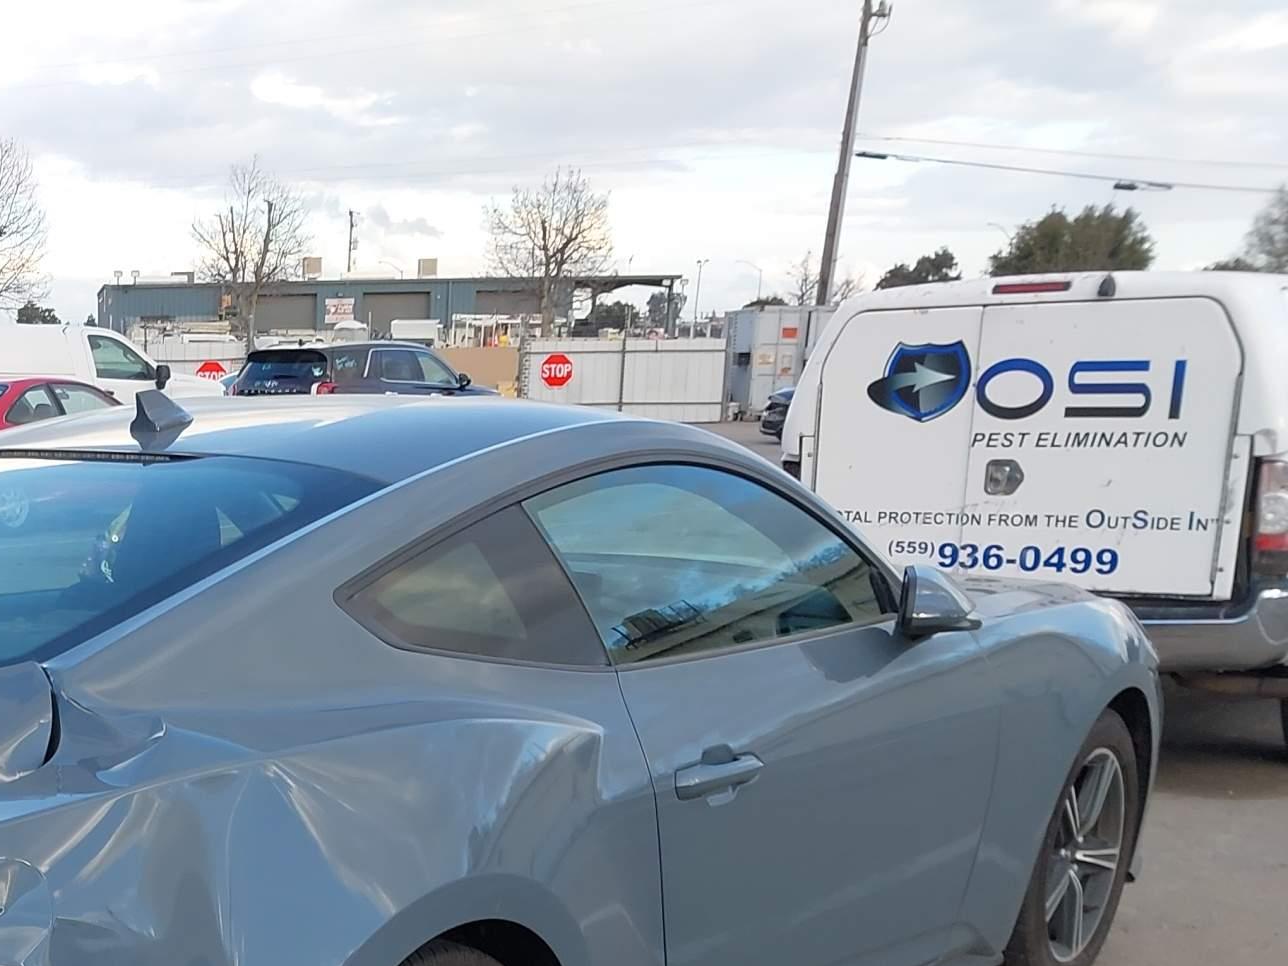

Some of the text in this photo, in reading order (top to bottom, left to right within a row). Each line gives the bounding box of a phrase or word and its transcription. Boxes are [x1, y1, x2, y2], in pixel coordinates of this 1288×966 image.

[542, 363, 572, 378] STOP
[976, 358, 1187, 420] OSI
[971, 431, 1188, 448] PEST ELIMINATION
[836, 510, 872, 523] TAL
[877, 511, 982, 527] PROTECTION
[987, 513, 1038, 528] FROM
[1044, 514, 1080, 529] THE
[887, 540, 1120, 575] (559) 936-0499
